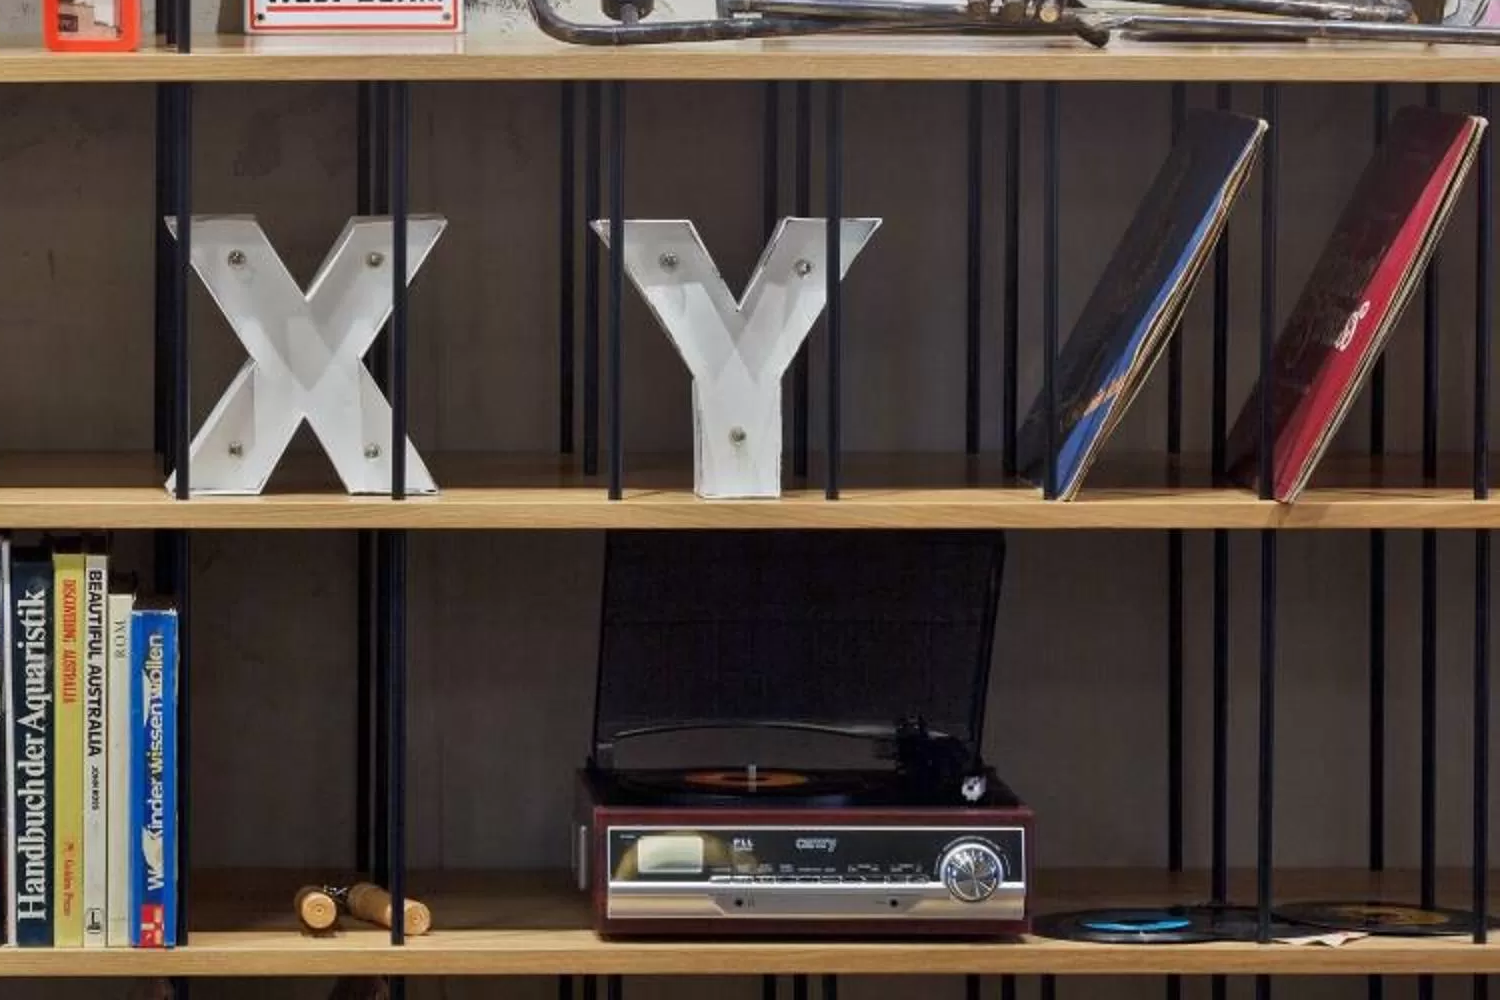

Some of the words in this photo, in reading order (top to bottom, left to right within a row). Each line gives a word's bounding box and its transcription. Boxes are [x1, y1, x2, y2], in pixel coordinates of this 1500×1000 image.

[164, 213, 448, 497] X
[589, 216, 884, 500] Y
[16, 589, 52, 732] Aquaristik
[87, 569, 103, 662] BEAUTIFUL
[17, 733, 46, 777] der
[87, 663, 103, 757] AUSTRALIA
[147, 702, 165, 774] wissen
[17, 779, 47, 921] Handbuch
